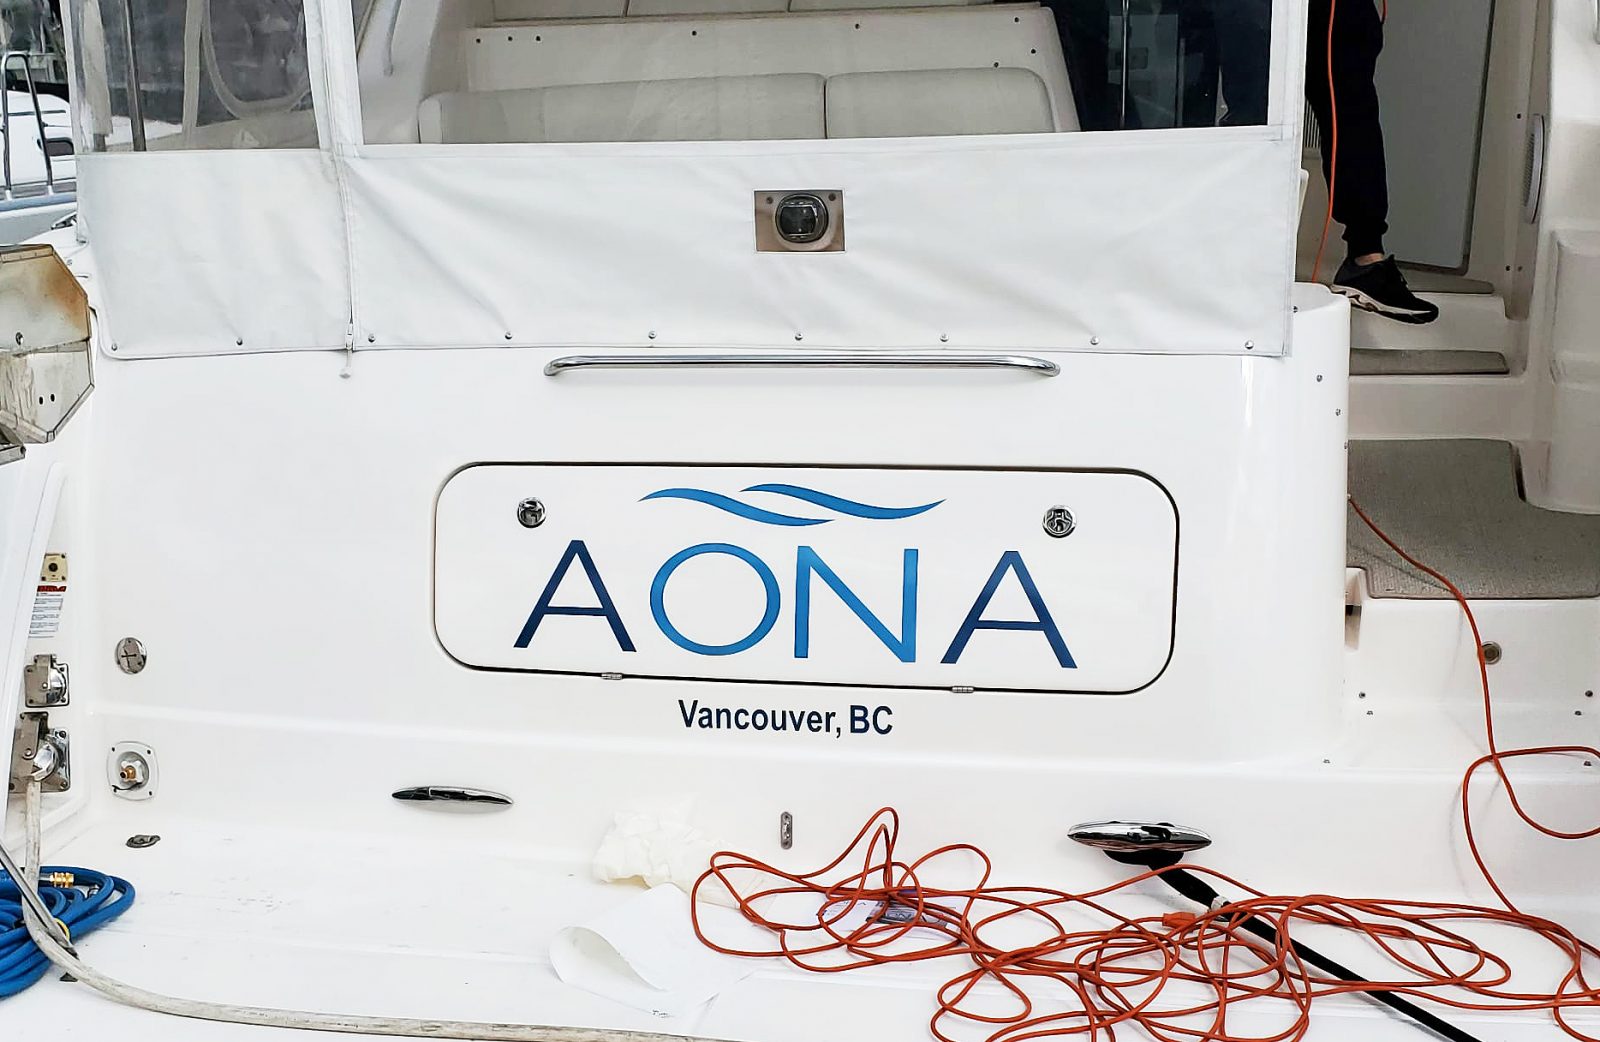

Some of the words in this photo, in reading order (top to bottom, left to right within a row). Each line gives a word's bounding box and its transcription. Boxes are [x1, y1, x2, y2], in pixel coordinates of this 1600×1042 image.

[513, 540, 1078, 670] AONA
[678, 699, 842, 738] Vancouver,
[850, 704, 894, 736] BC
